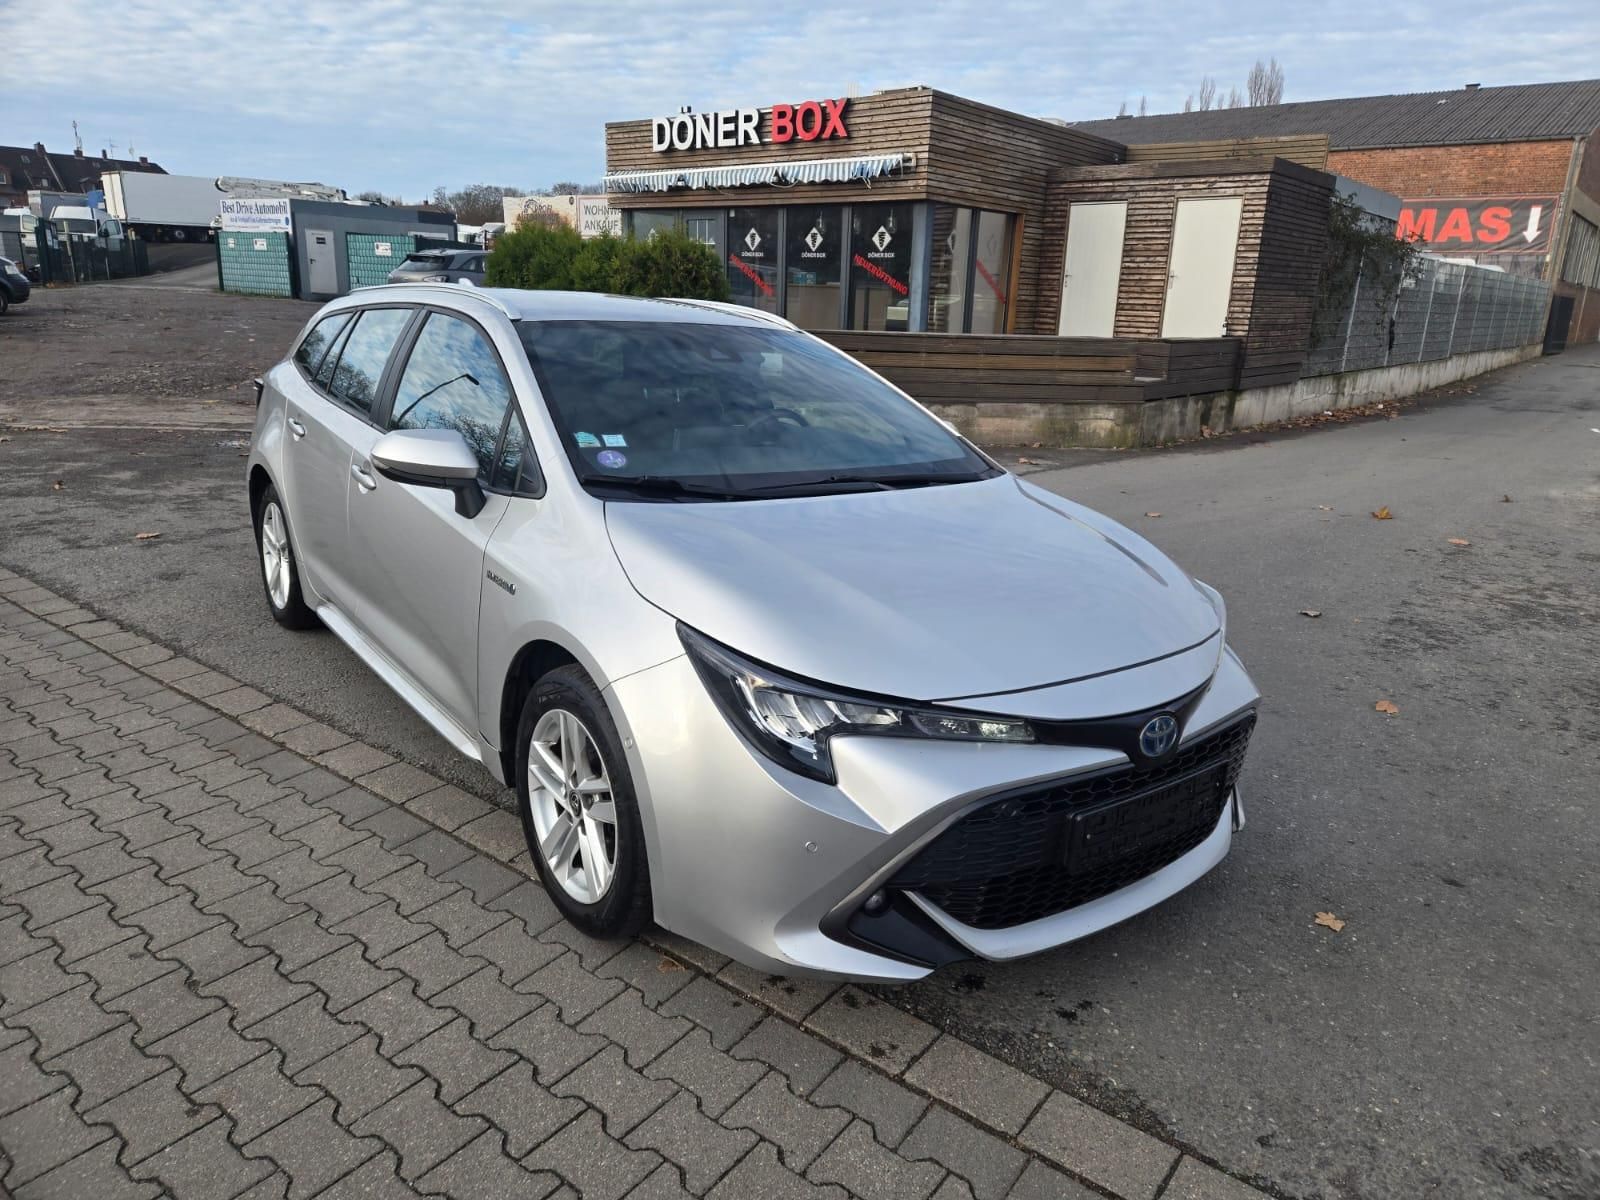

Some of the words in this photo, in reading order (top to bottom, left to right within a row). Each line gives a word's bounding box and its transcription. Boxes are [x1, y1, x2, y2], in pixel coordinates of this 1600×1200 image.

[652, 105, 760, 152] DÖNER
[771, 98, 848, 144] BOX
[222, 201, 235, 214] Best
[236, 201, 253, 215] Drive
[254, 201, 288, 215] Automobil
[584, 219, 619, 231] ANKAUF
[1395, 206, 1513, 243] MAS
